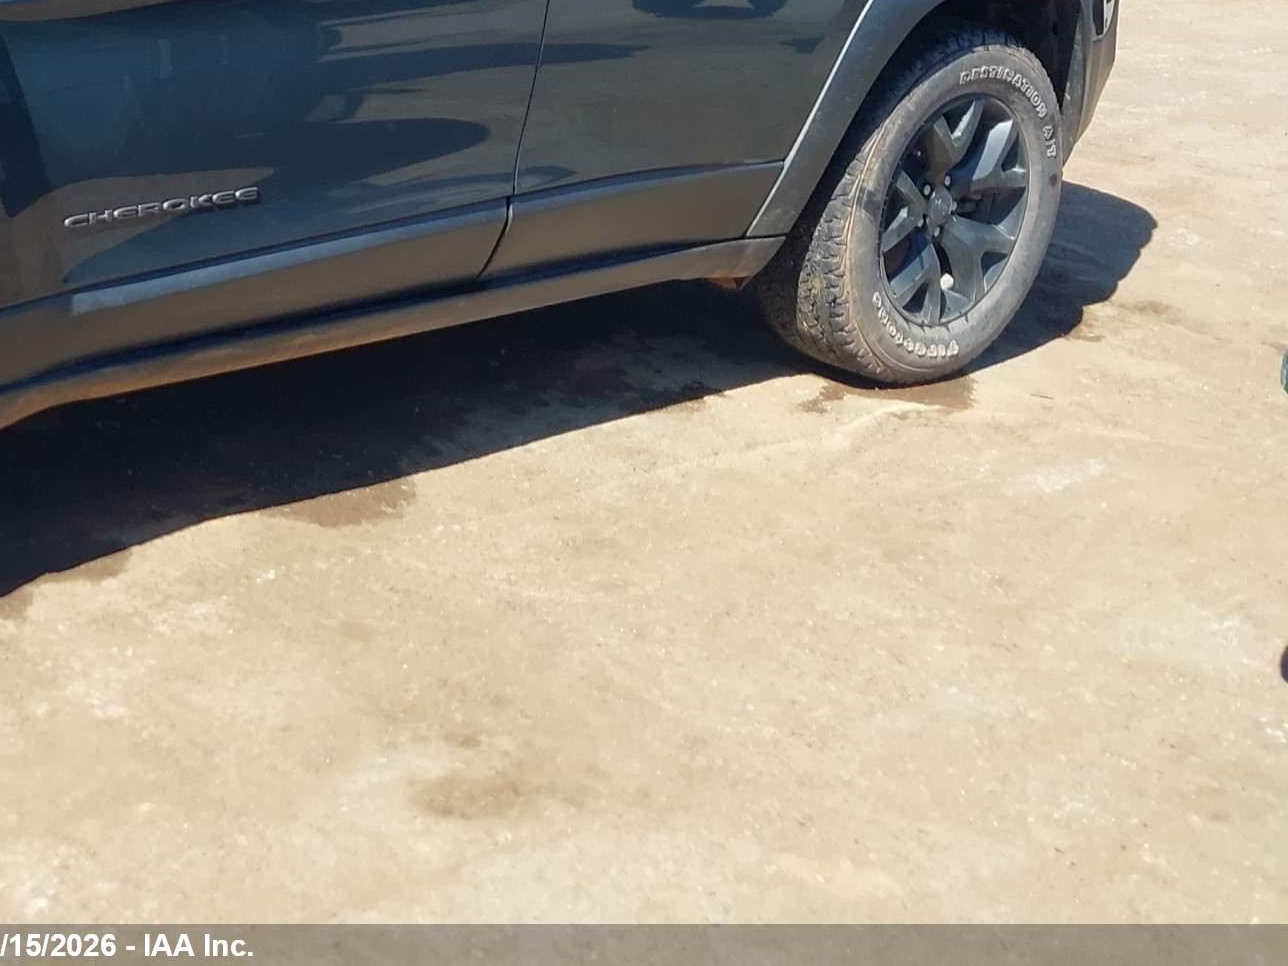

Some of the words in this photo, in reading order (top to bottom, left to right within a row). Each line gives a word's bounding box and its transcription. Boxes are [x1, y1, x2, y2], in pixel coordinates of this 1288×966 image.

[959, 65, 1048, 118] DESTINATION
[1042, 125, 1058, 158] A/T
[63, 186, 259, 228] CHEROKEE
